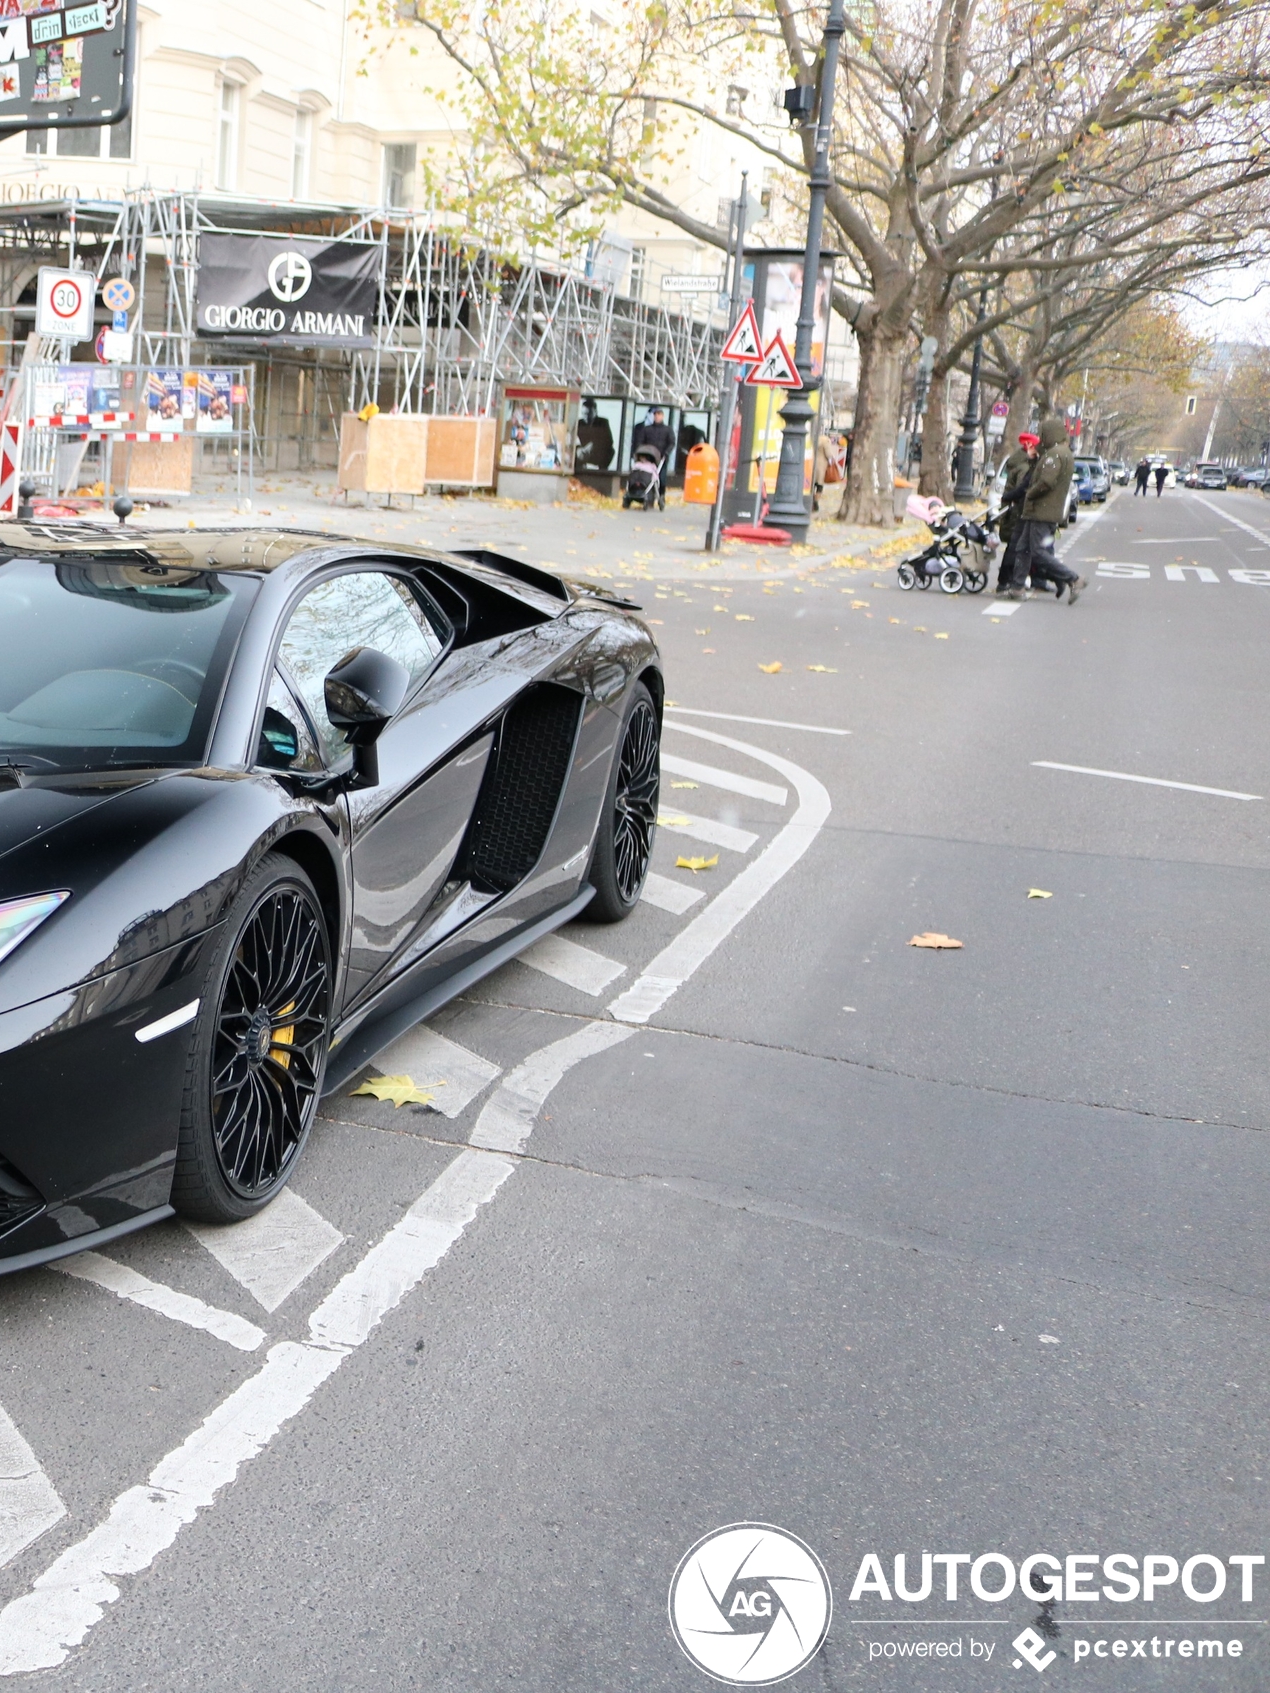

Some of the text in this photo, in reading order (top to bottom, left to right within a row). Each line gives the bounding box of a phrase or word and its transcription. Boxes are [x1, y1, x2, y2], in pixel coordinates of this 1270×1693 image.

[56, 289, 76, 308] 30
[52, 320, 77, 332] ZONE
[204, 303, 286, 332] GIORGIO
[290, 310, 365, 337] ARMANI
